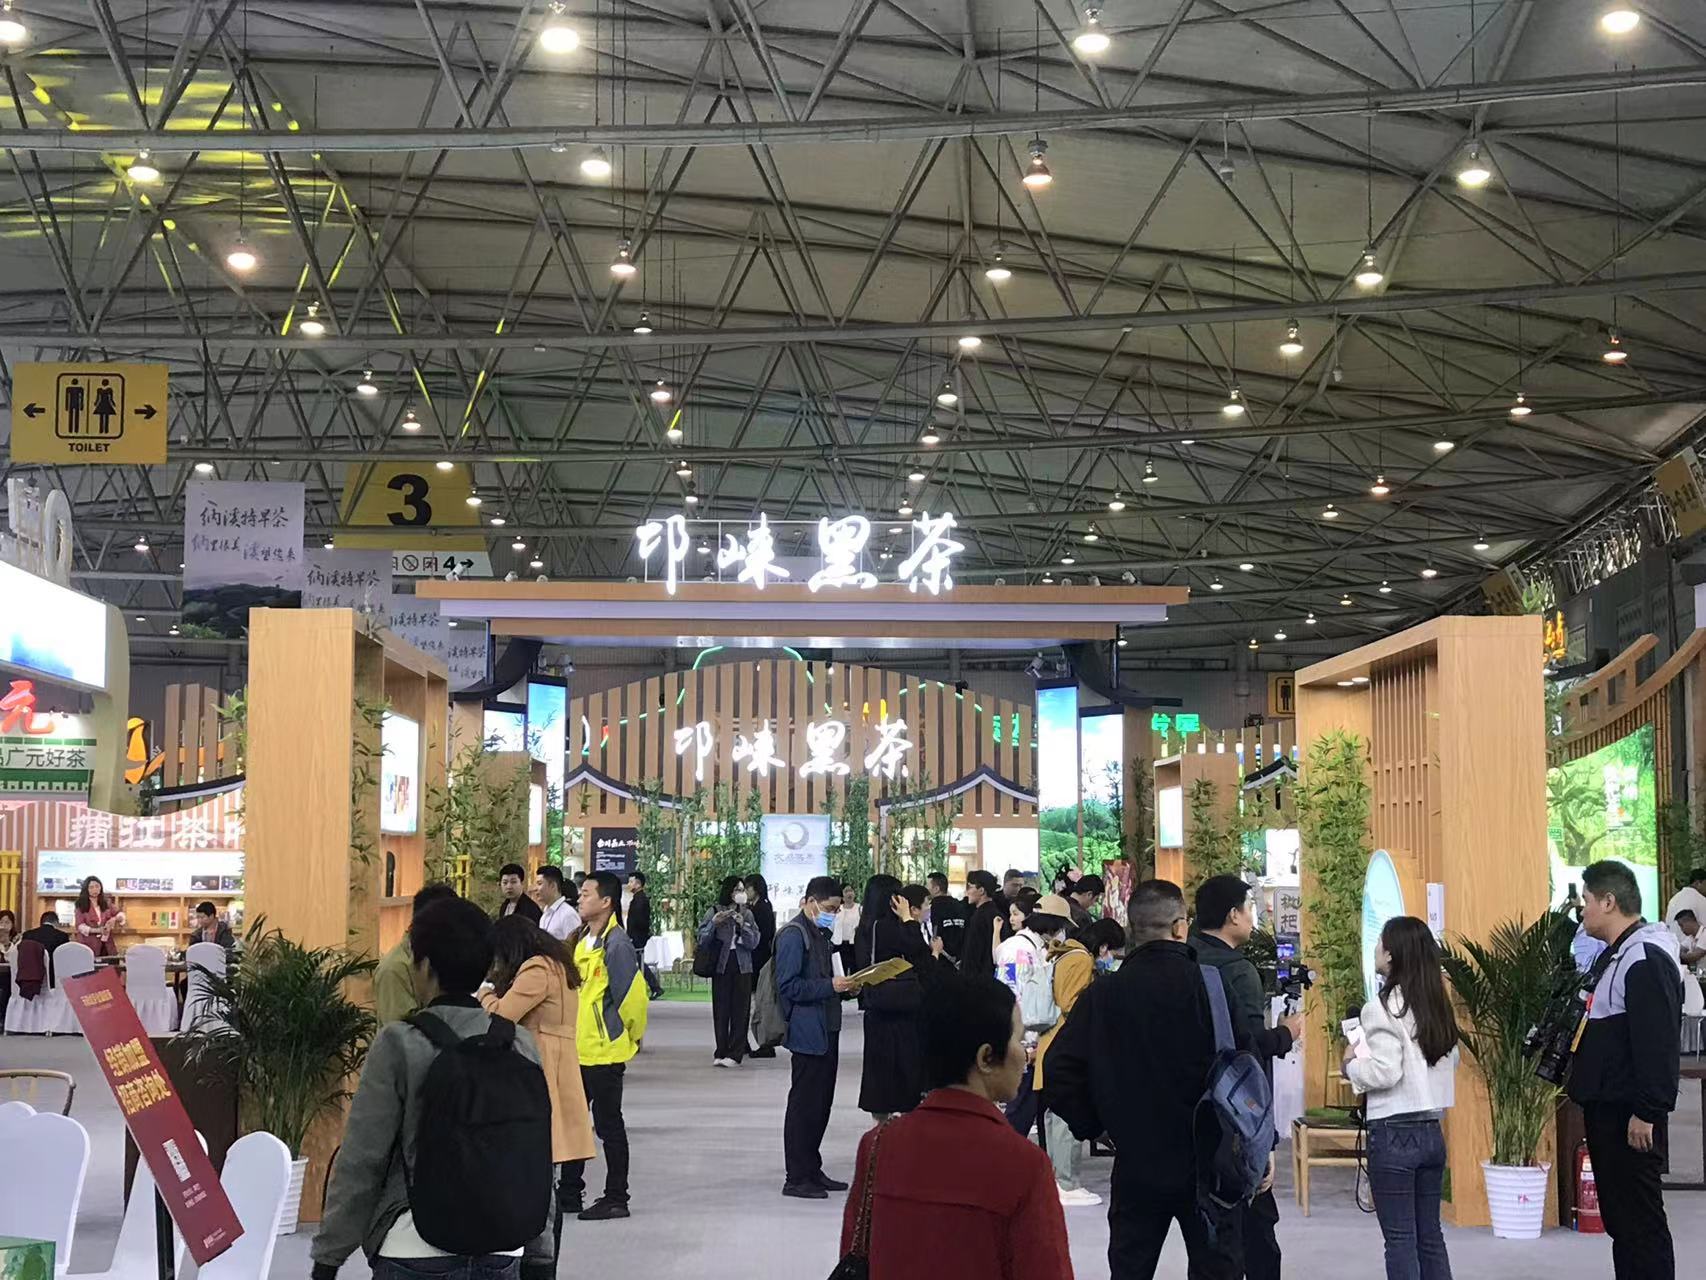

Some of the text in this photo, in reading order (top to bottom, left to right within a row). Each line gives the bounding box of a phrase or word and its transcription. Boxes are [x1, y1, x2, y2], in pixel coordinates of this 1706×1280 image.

[68, 442, 110, 452] TOILET
[386, 473, 432, 526] 3
[0, 747, 86, 768] 广元好茶
